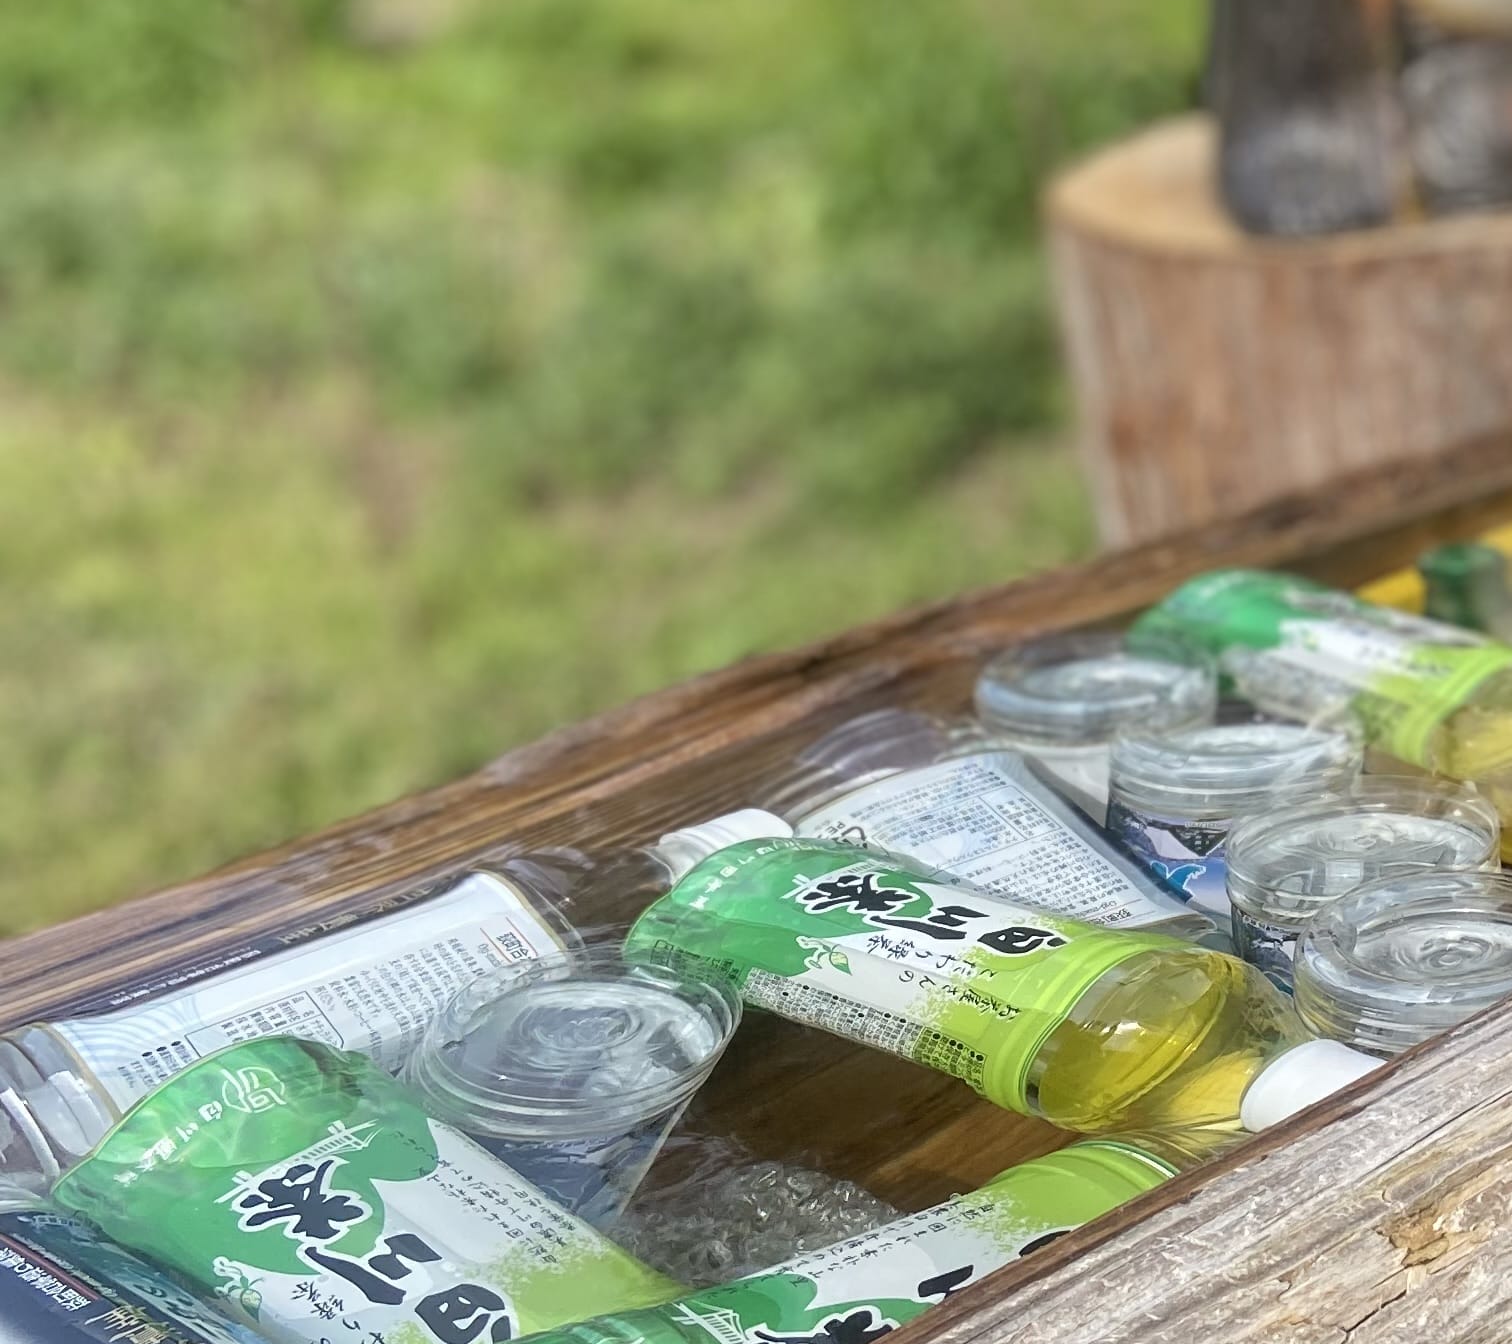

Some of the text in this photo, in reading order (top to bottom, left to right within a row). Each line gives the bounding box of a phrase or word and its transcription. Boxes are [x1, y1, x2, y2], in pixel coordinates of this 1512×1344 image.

[802, 873, 1067, 954] 白川茶
[495, 931, 534, 964] 荻町合
[866, 935, 996, 979] こだわり緑茶
[899, 971, 1022, 1023] お茶屋さんの
